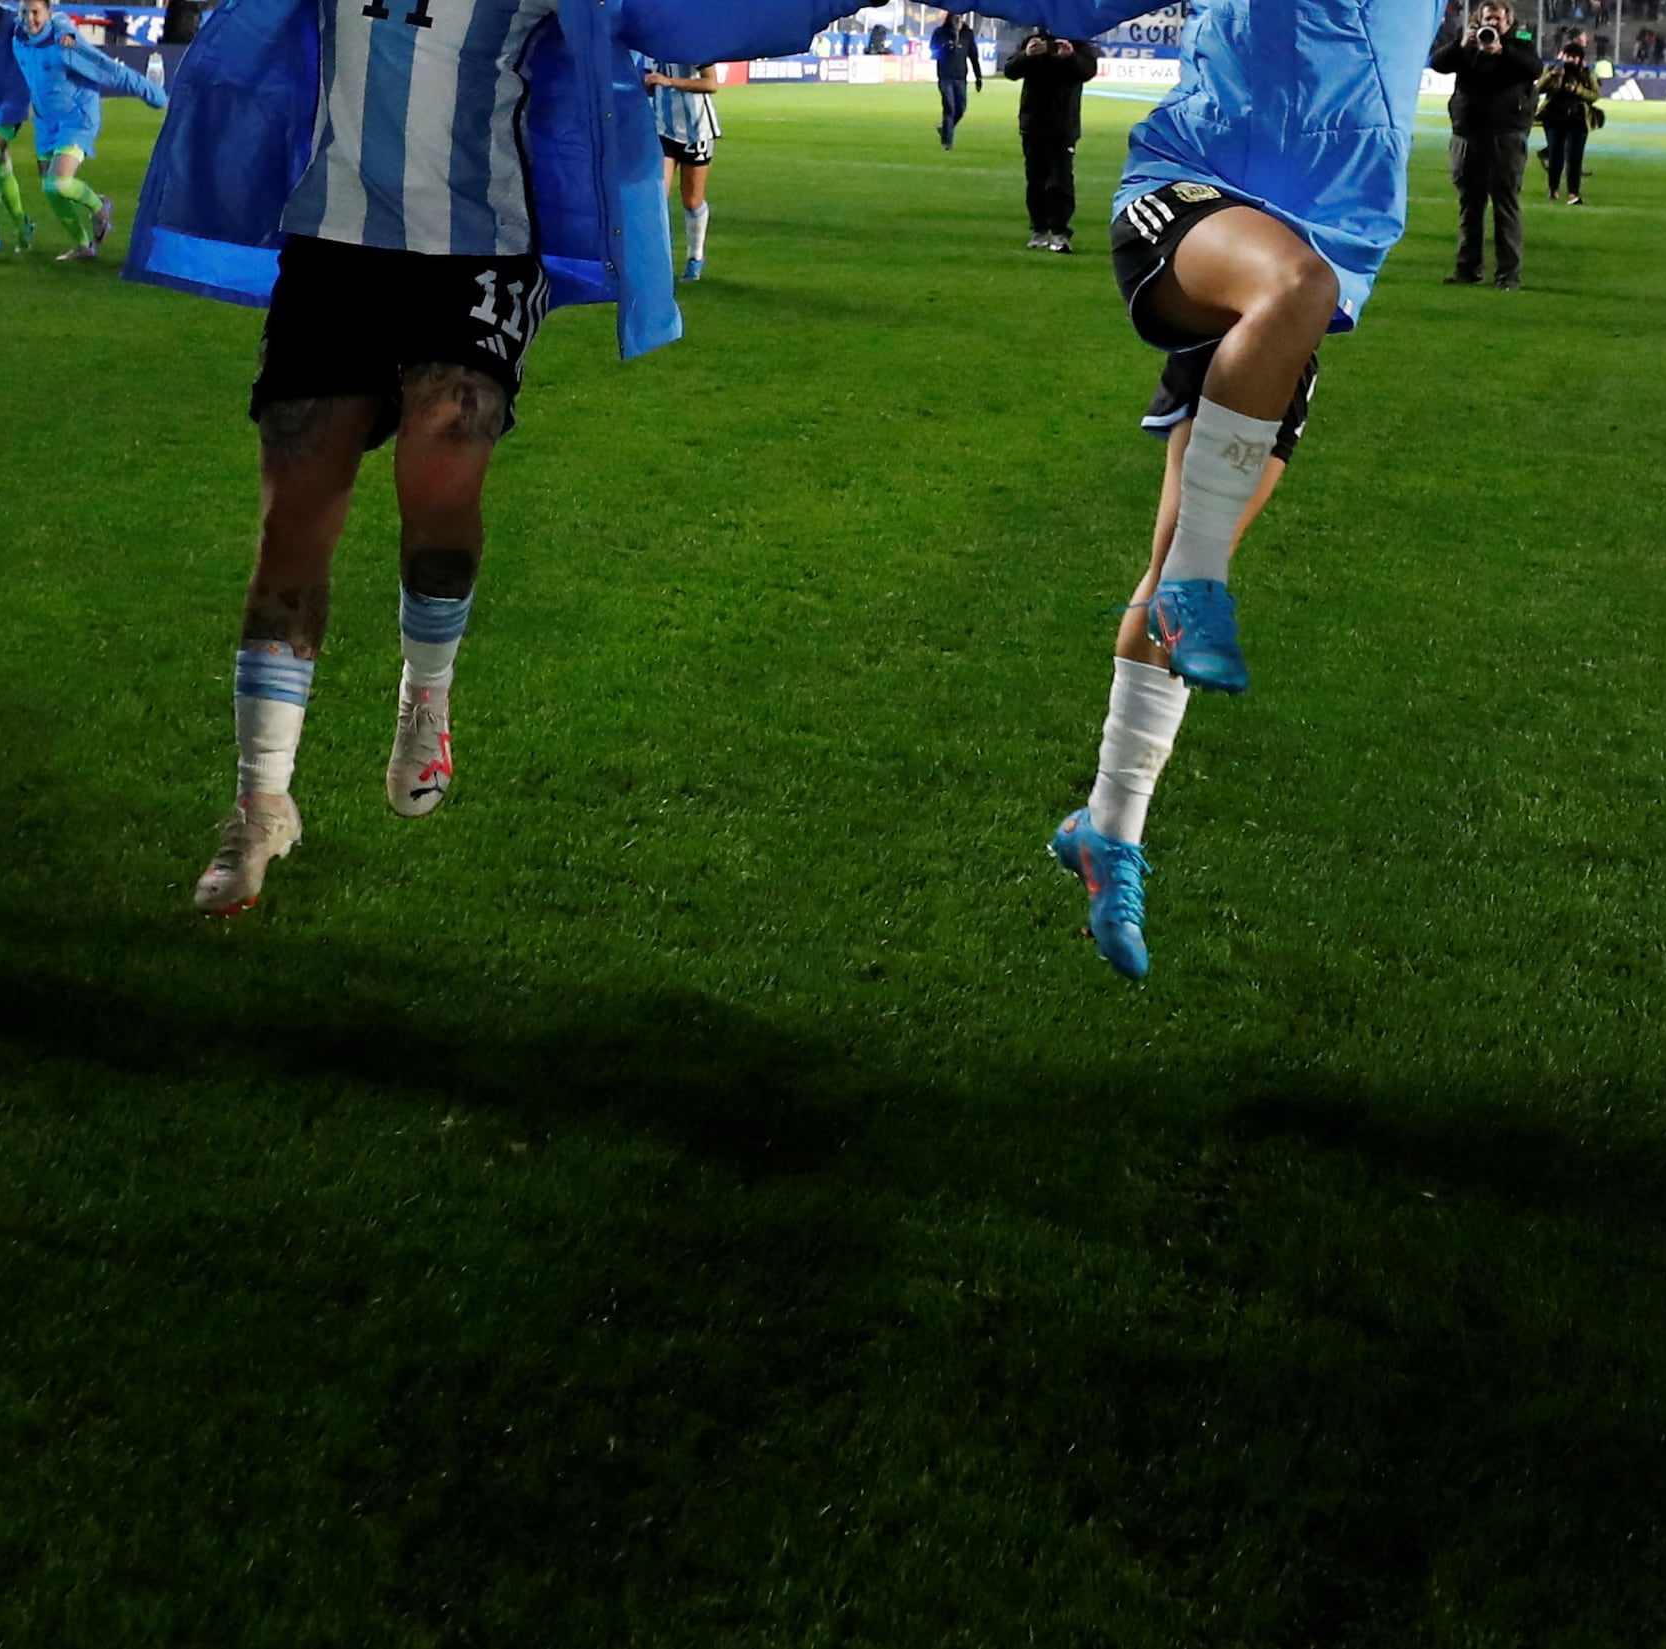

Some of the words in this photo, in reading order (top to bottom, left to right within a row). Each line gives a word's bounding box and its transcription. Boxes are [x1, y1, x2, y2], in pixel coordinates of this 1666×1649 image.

[122, 15, 165, 43] YP
[1130, 23, 1185, 46] COR
[1116, 65, 1181, 79] BETWA
[469, 269, 525, 342] 11
